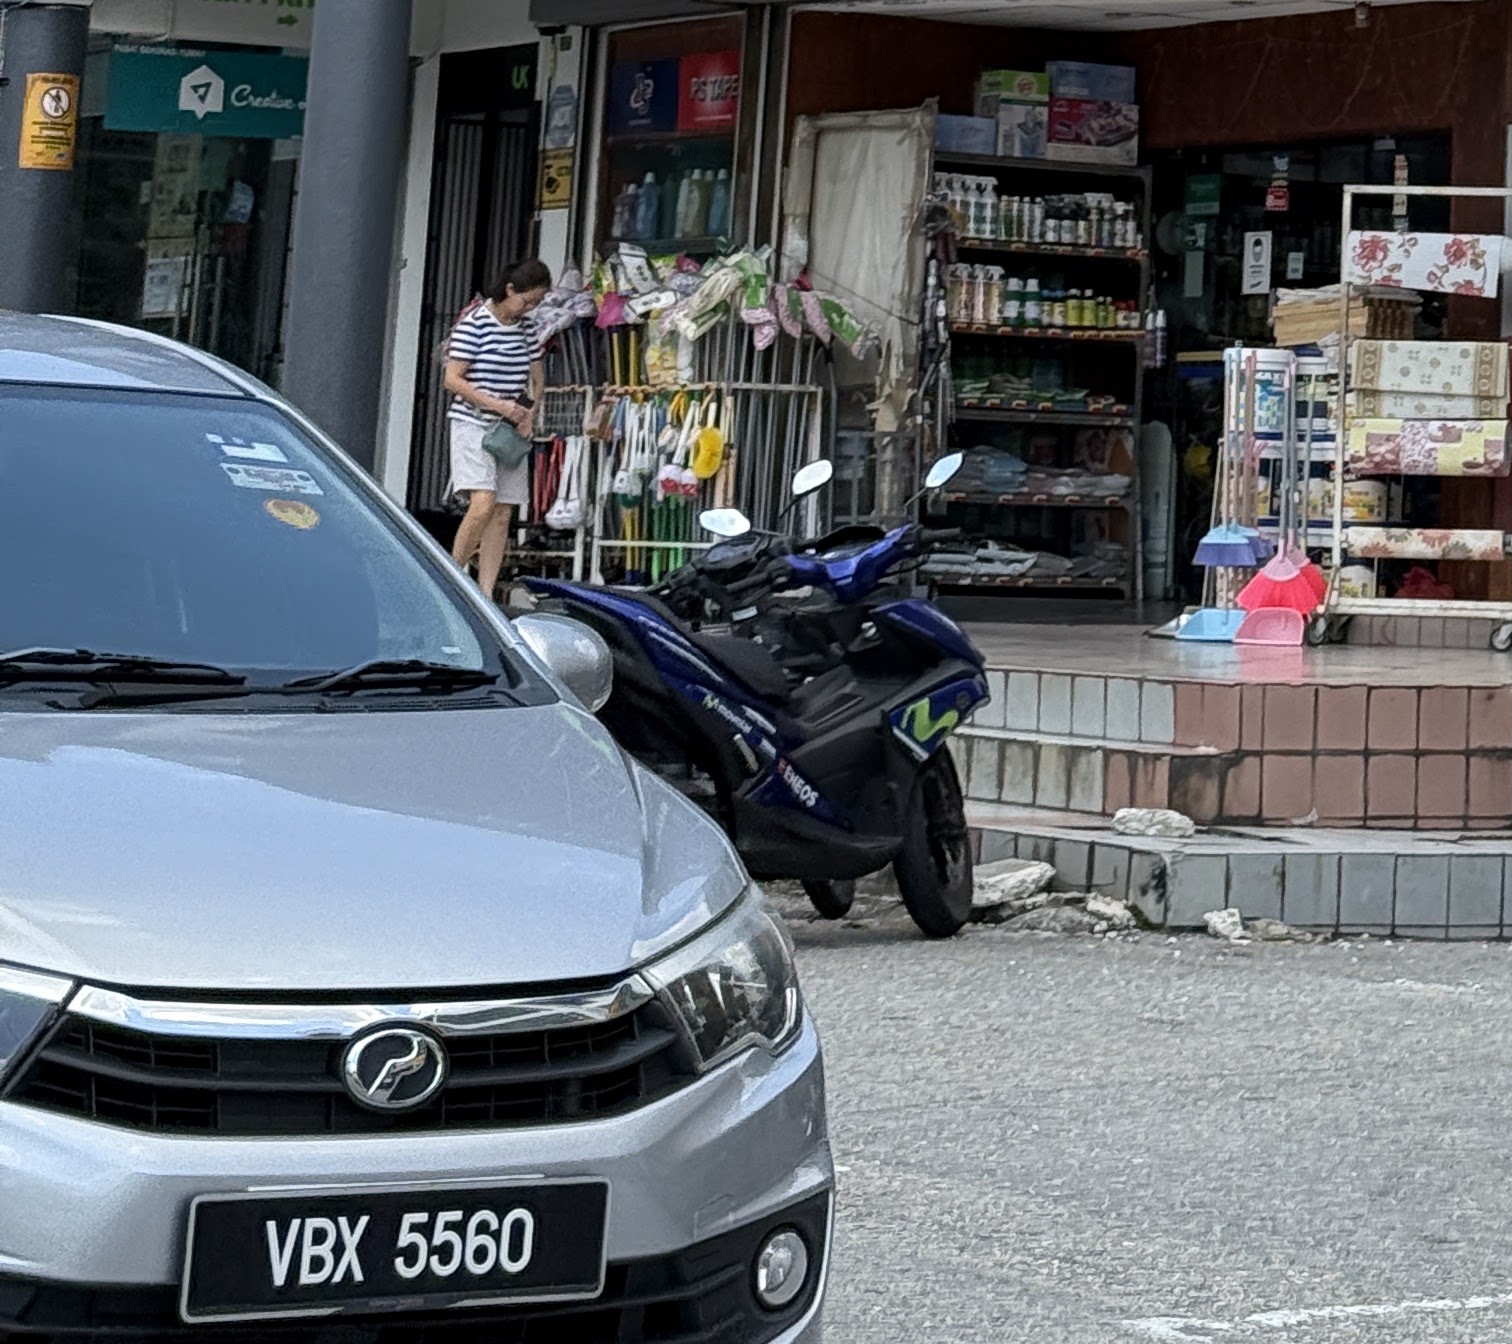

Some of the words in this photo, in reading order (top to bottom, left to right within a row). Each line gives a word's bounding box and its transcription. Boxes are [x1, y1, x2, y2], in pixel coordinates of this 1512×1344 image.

[783, 765, 819, 808] ENEOS
[266, 1215, 370, 1287] VBX
[394, 1208, 534, 1279] 5560
